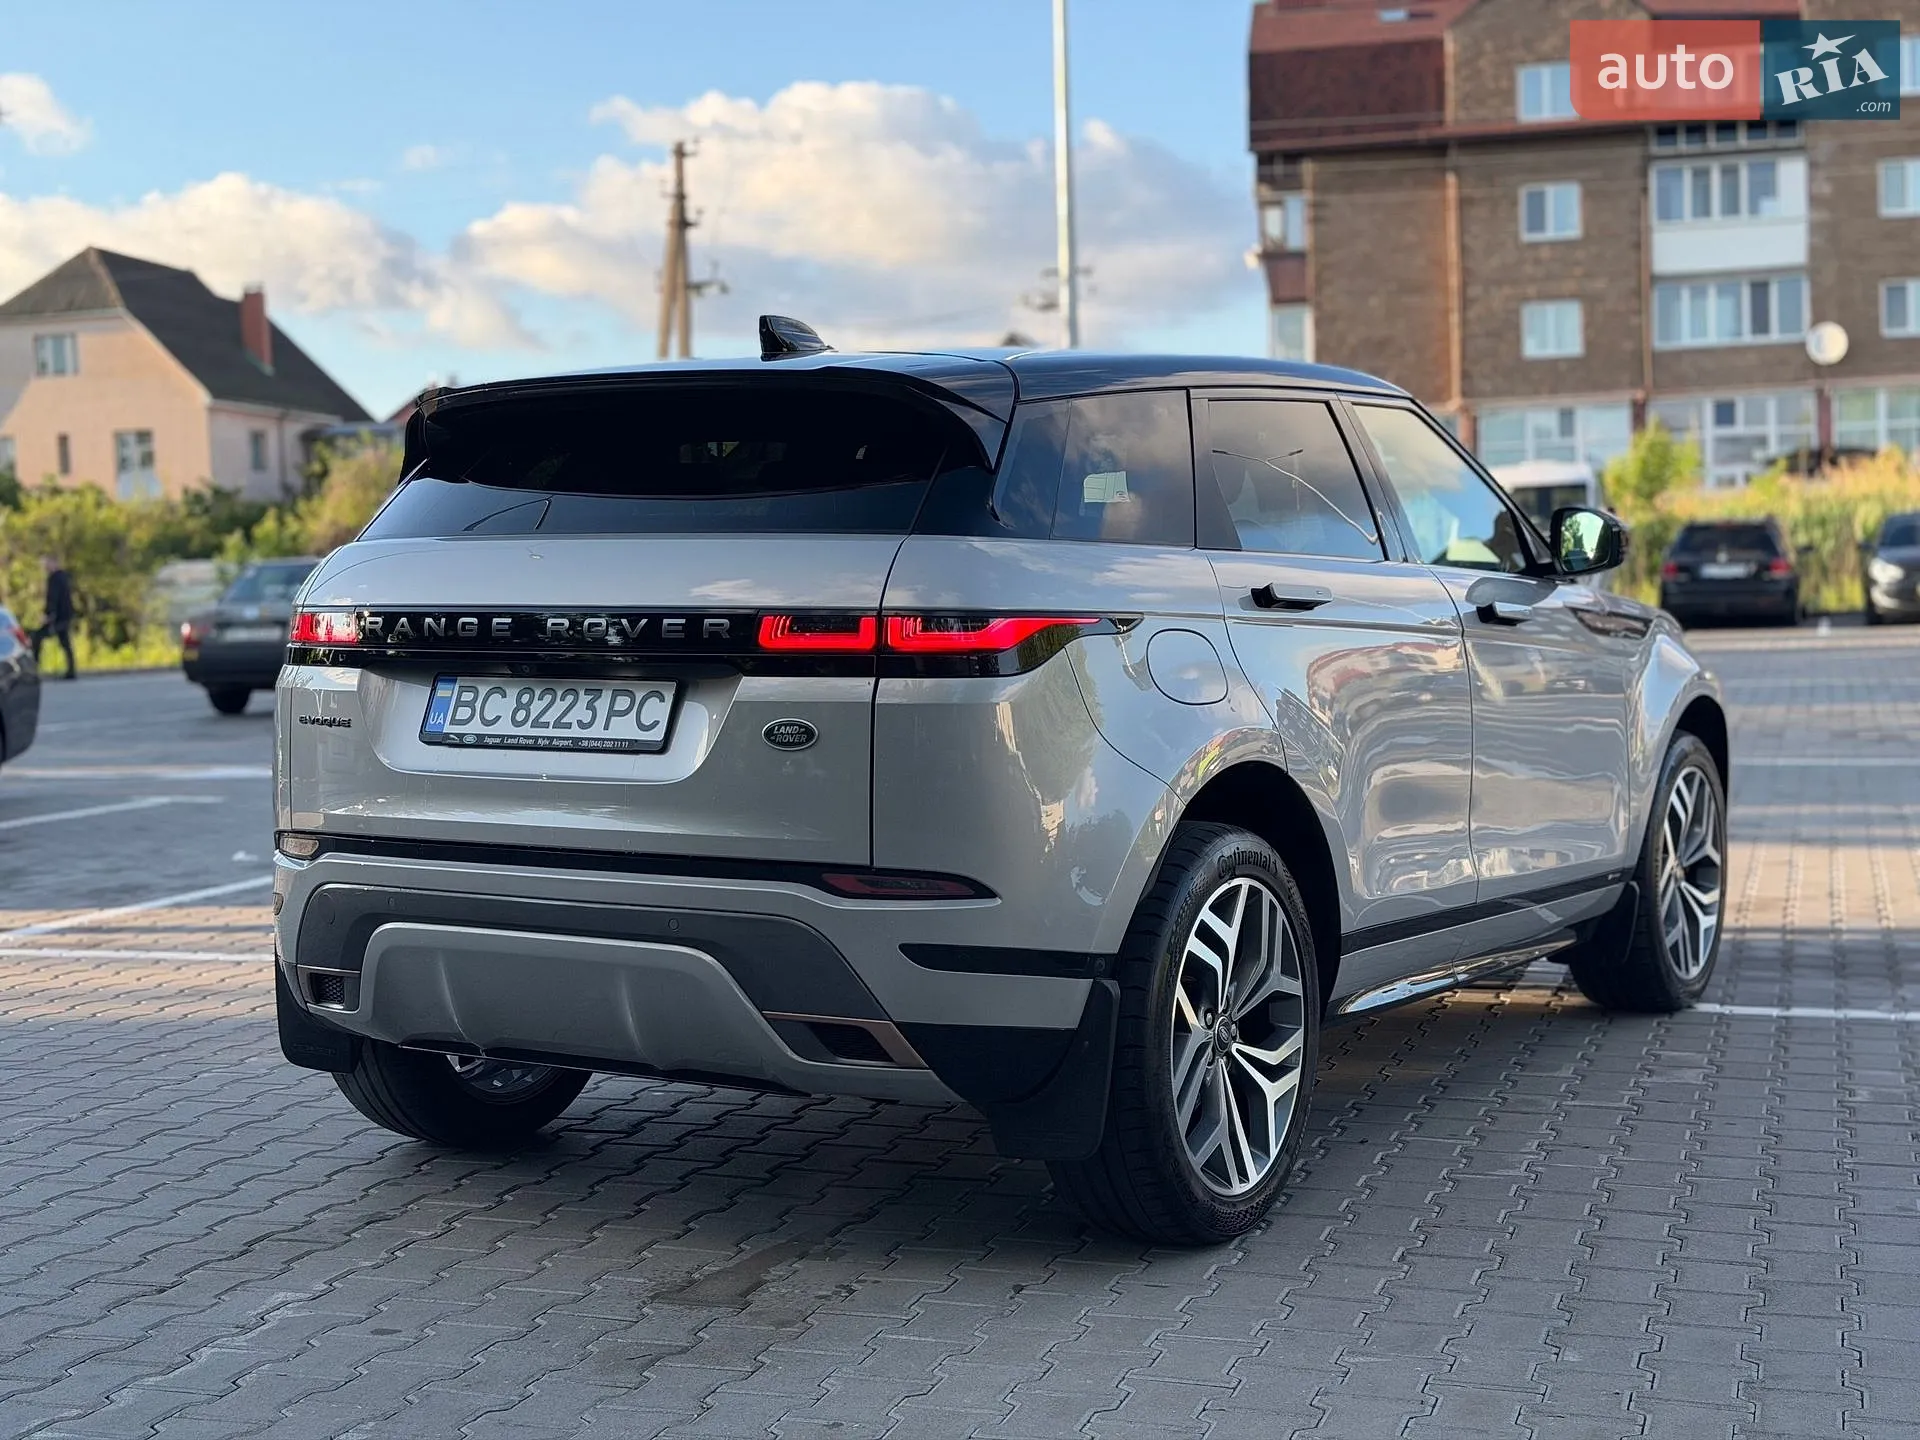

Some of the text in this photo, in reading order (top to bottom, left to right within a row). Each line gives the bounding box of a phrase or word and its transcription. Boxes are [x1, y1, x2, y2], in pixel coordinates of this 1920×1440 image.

[365, 617, 730, 639] RANGE ROVER
[430, 712, 444, 725] UA
[484, 736, 502, 744] Jaguar
[519, 737, 535, 745] Rover
[537, 738, 550, 746] Kyiv
[1217, 846, 1271, 879] Continental
